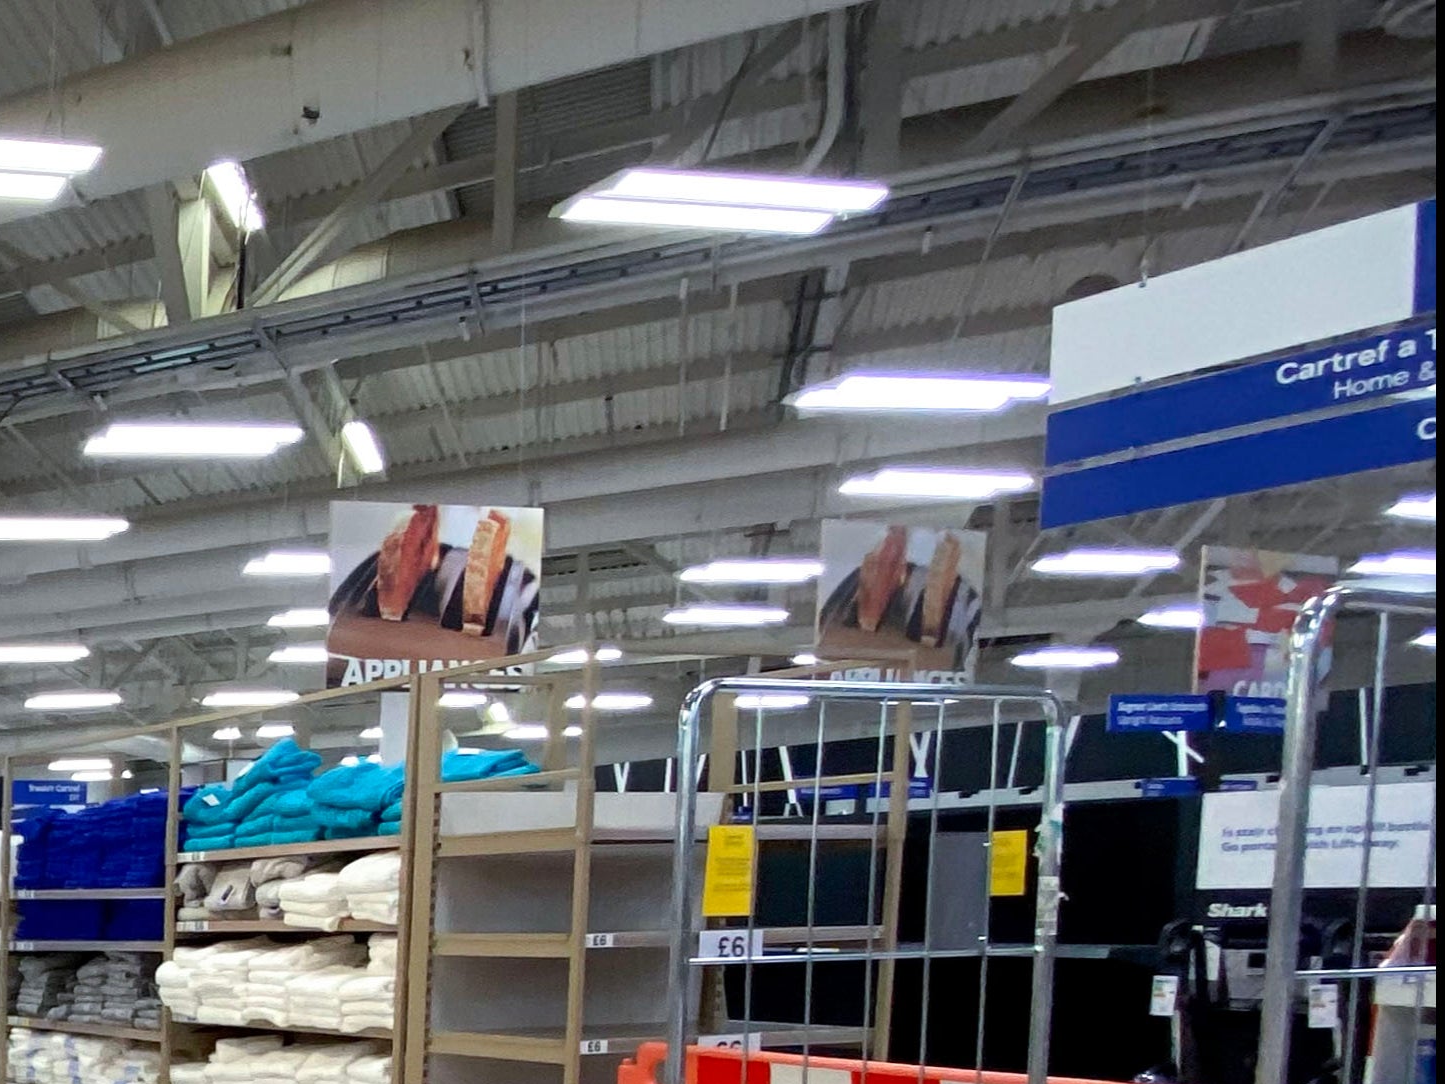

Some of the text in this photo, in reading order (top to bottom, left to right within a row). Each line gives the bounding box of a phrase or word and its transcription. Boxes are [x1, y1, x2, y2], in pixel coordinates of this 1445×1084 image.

[1276, 339, 1390, 384] Cartref
[1397, 340, 1417, 358] a
[1333, 361, 1436, 399] Home &
[1207, 903, 1267, 918] Shark
[593, 935, 607, 946] £6
[717, 936, 745, 957] £6
[587, 1041, 602, 1052] £6
